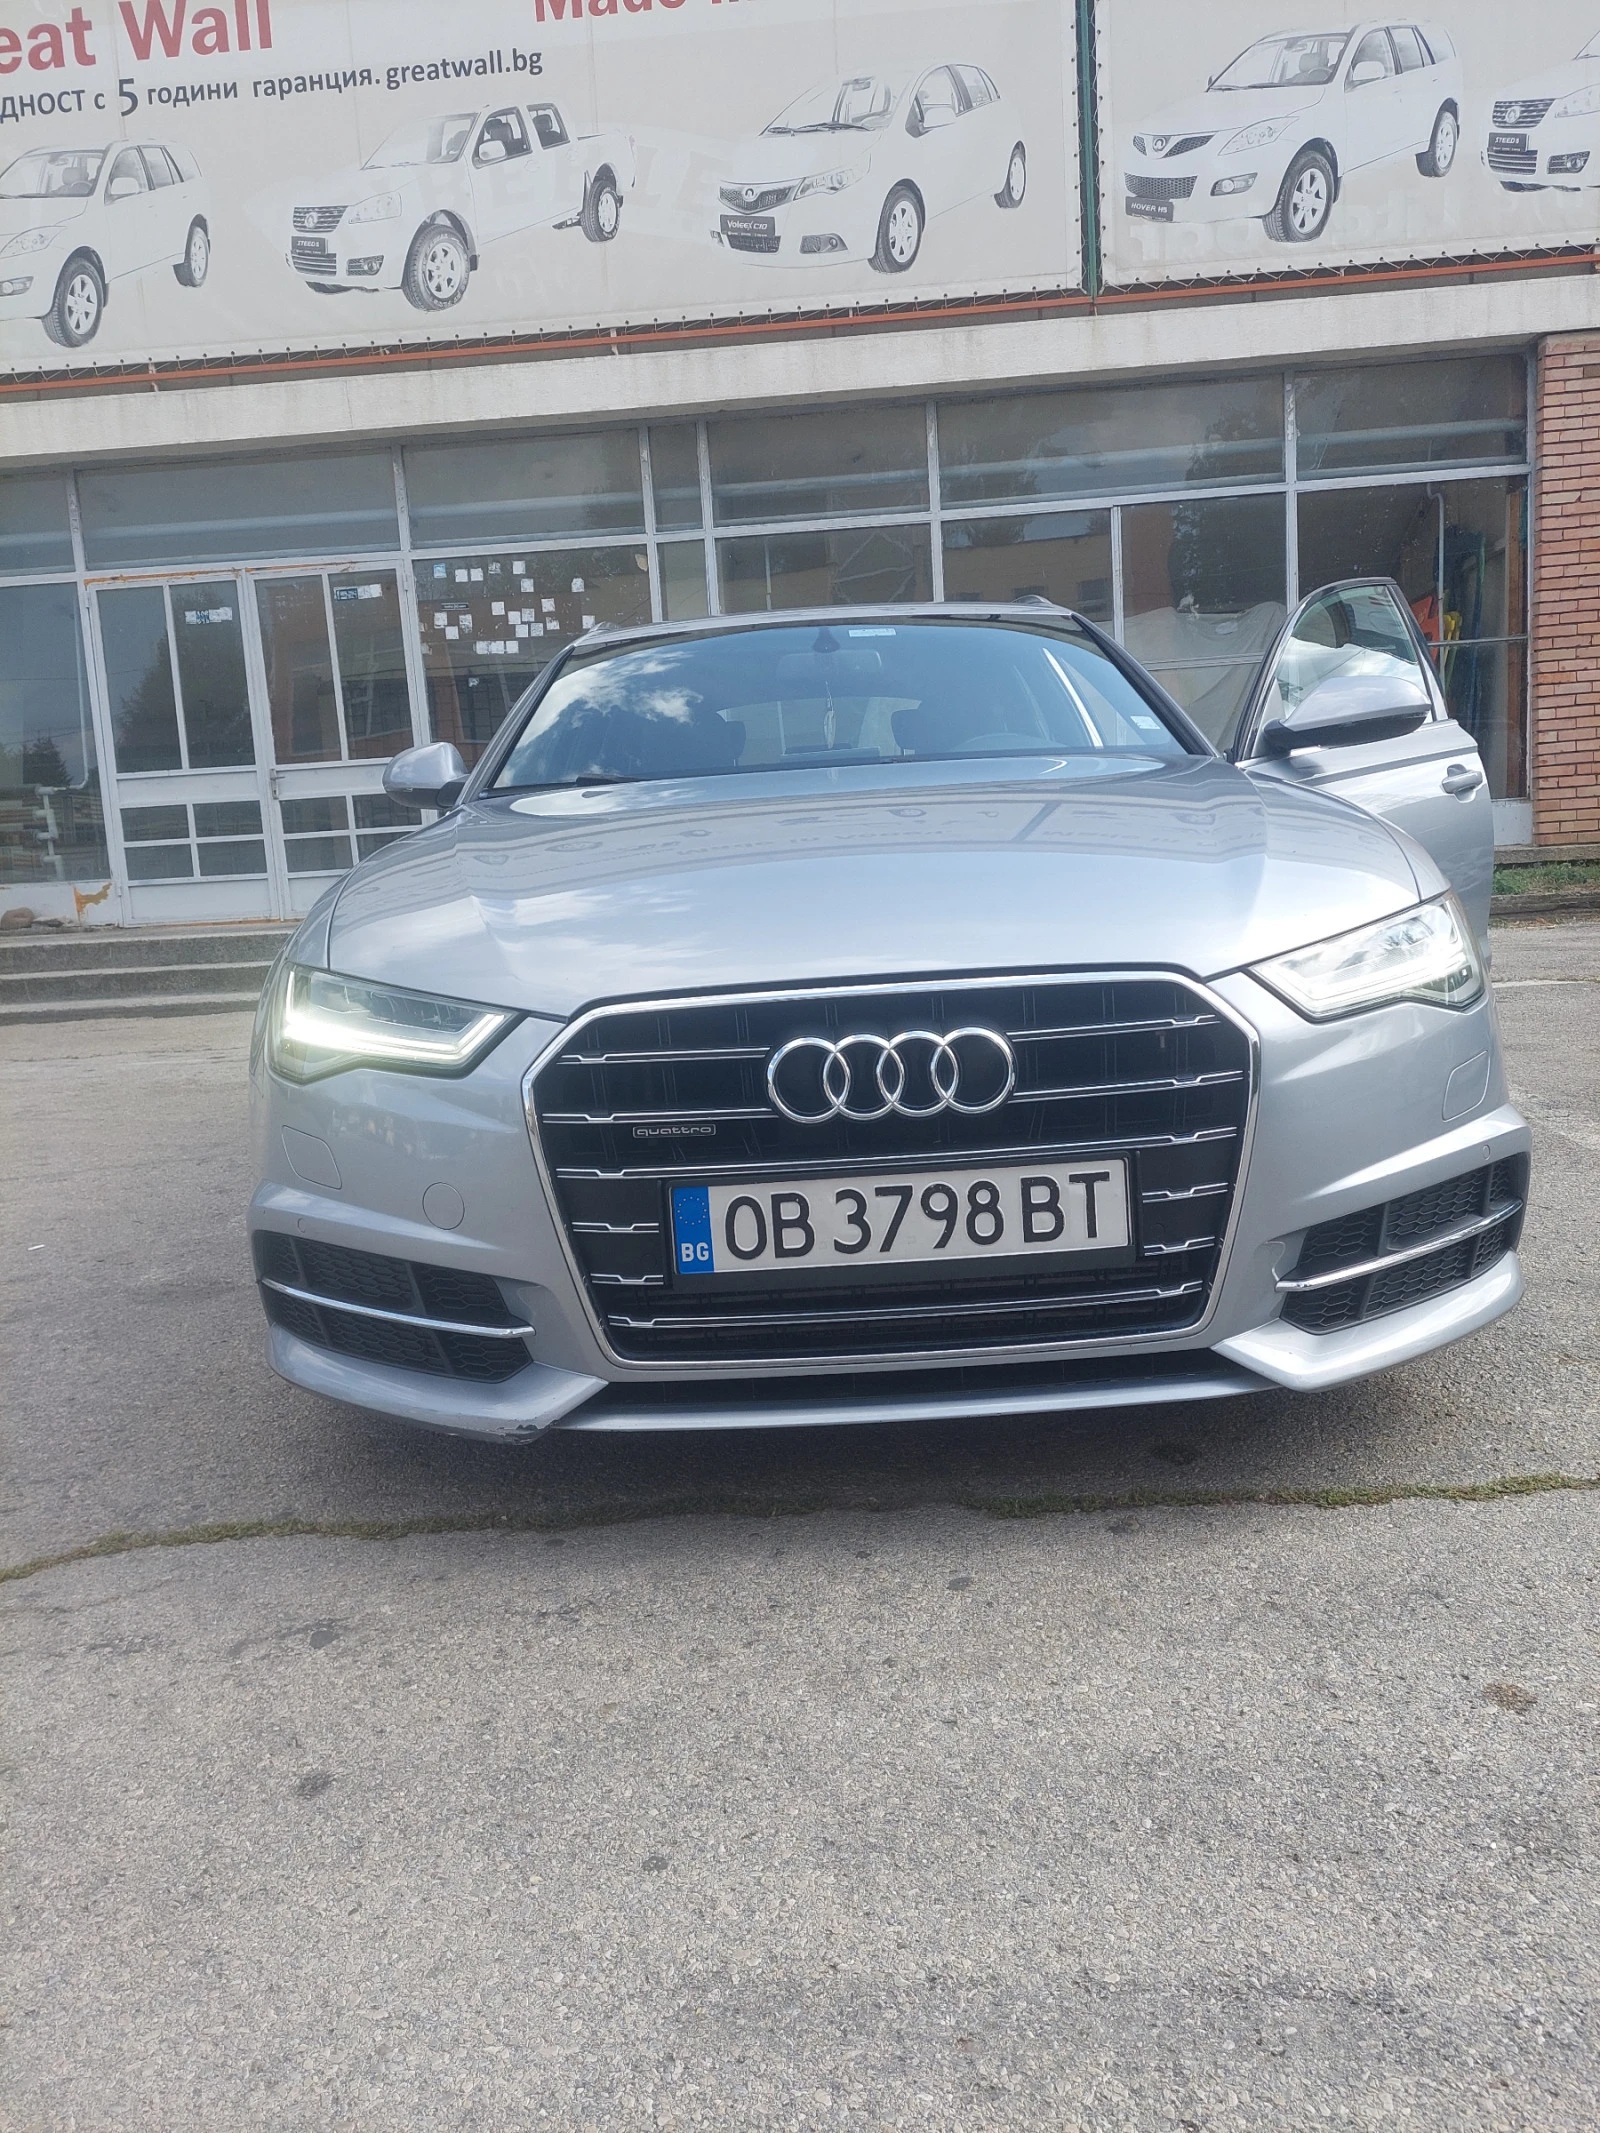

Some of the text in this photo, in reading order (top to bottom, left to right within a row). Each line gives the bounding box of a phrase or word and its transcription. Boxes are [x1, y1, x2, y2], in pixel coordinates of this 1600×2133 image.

[119, 0, 272, 61] Wall
[118, 78, 138, 117] 5
[147, 81, 238, 108] години
[252, 68, 381, 100] гаранция.
[386, 48, 543, 90] greatwall.bg
[1131, 202, 1156, 212] HOVER
[637, 1126, 712, 1136] quattro
[724, 1171, 1111, 1261] OB 3798 BT
[681, 1242, 710, 1263] BG
